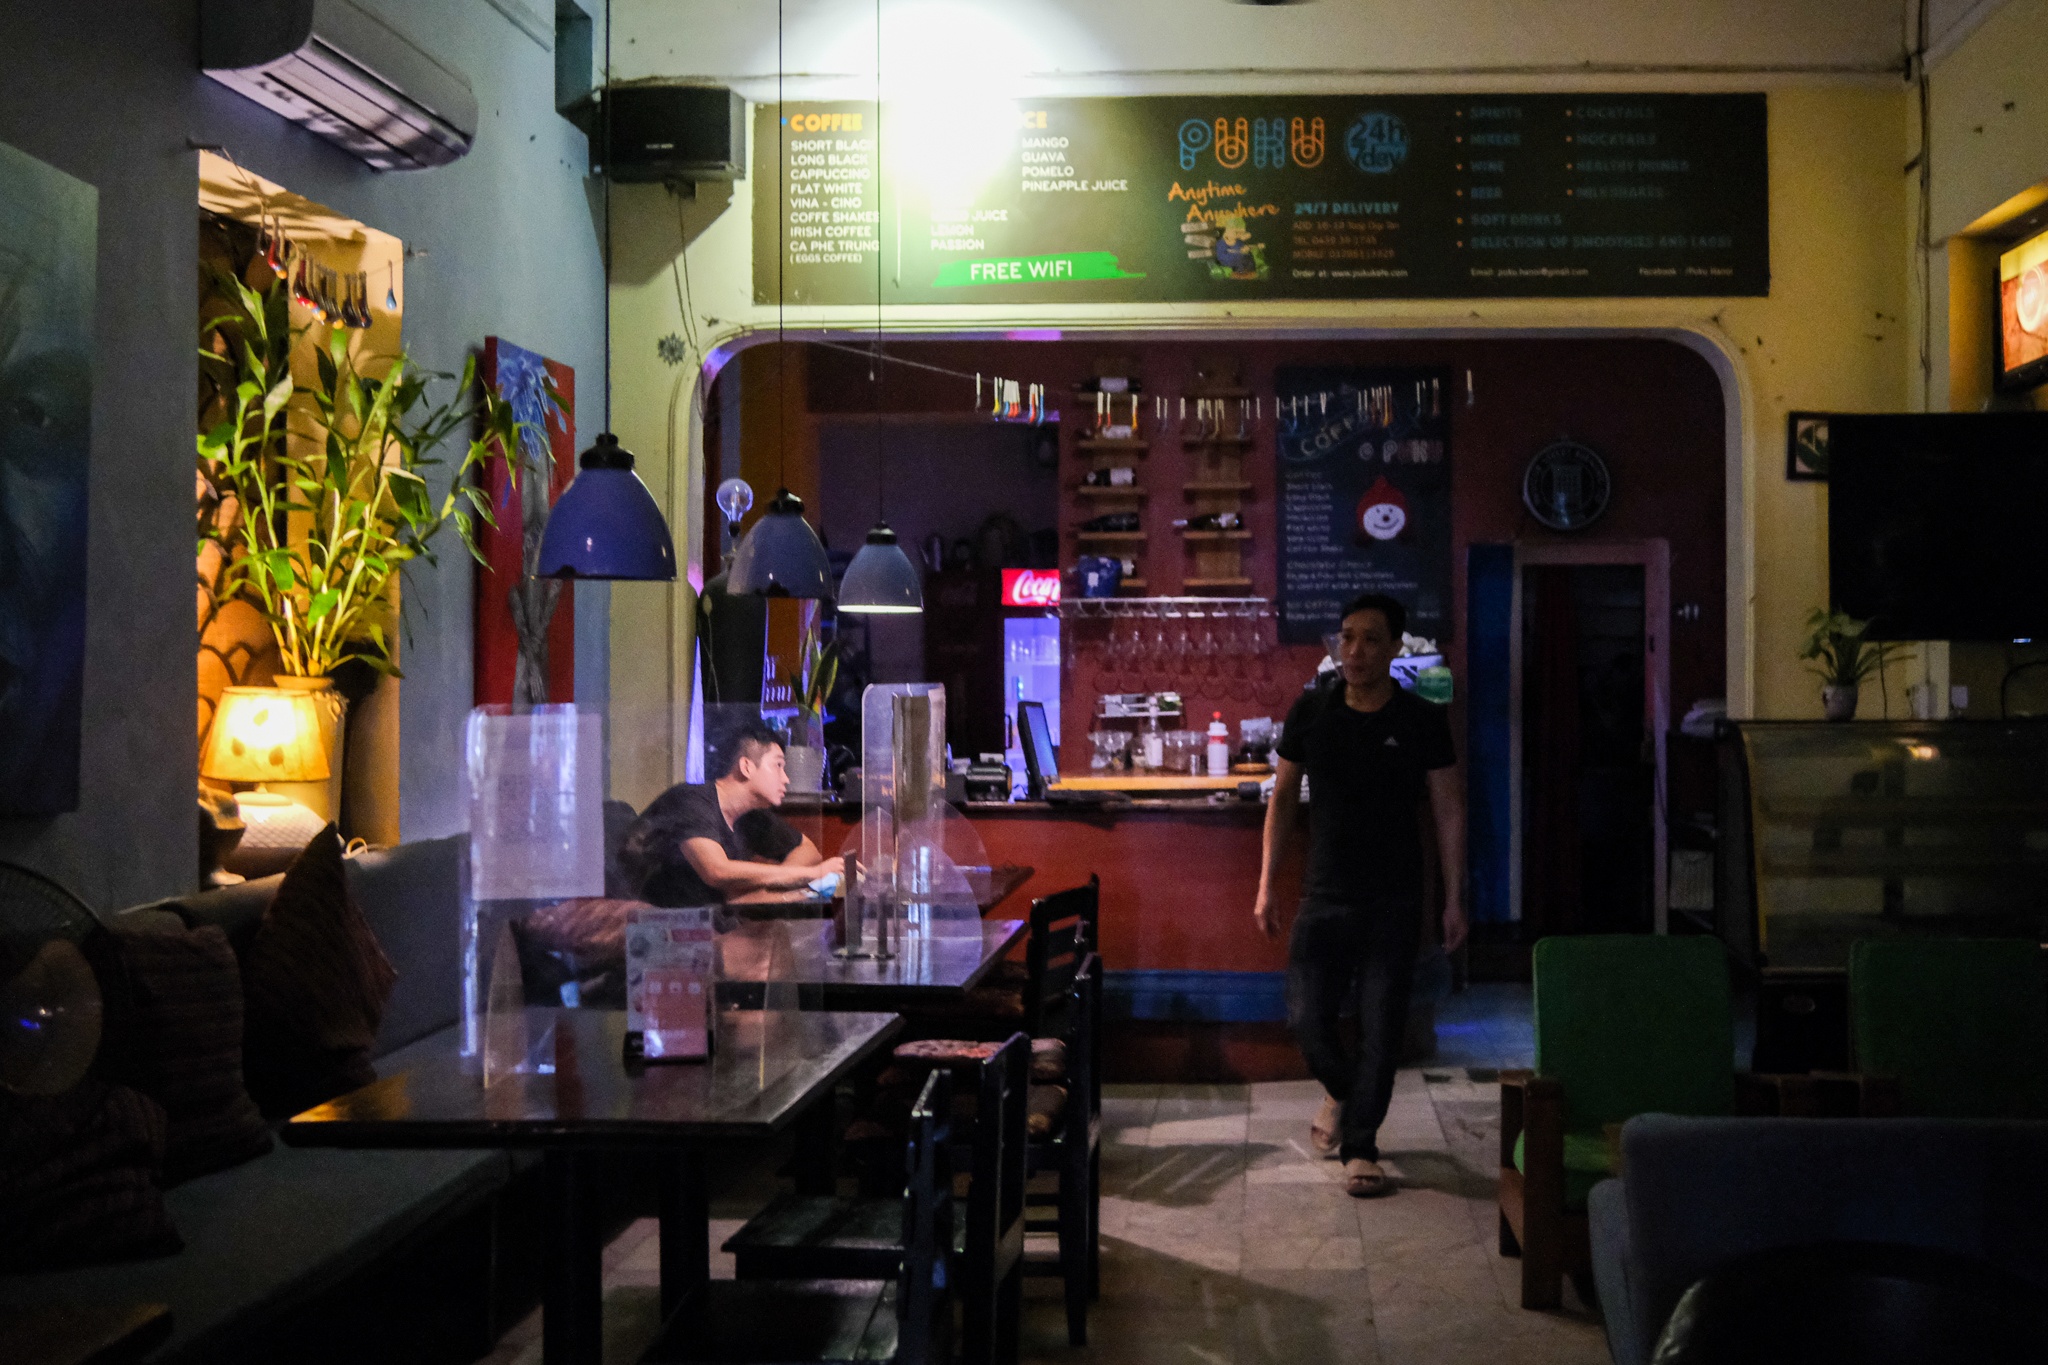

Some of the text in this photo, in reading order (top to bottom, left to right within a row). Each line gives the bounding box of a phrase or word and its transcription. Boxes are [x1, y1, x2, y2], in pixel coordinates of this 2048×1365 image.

[790, 113, 863, 132] COFFEE
[791, 140, 833, 152] SHORT
[1022, 136, 1069, 149] MANGO
[1177, 117, 1327, 170] PUKU
[791, 153, 869, 166] LONG BLACK
[1021, 151, 1066, 163] GUAVA
[790, 168, 871, 180] CAPPUCCINO
[1021, 165, 1075, 178] POMELO
[791, 182, 863, 195] FLAT WHITE
[1022, 179, 1128, 192] PINEAPPLE JUICE
[1168, 180, 1247, 206] Anytime
[790, 197, 820, 209] VINA
[830, 196, 863, 209] CINO
[1332, 202, 1399, 215] DELIVERY
[790, 211, 830, 223] COFFE
[971, 209, 1008, 221] JUICE
[790, 225, 872, 238] IRISH COFFEE
[931, 224, 975, 236] LEMON
[789, 239, 880, 252] CA PHE TRUNG
[931, 238, 985, 251] PASSION
[823, 252, 863, 264] COFFEE)
[970, 260, 1072, 280] FREE WIFI
